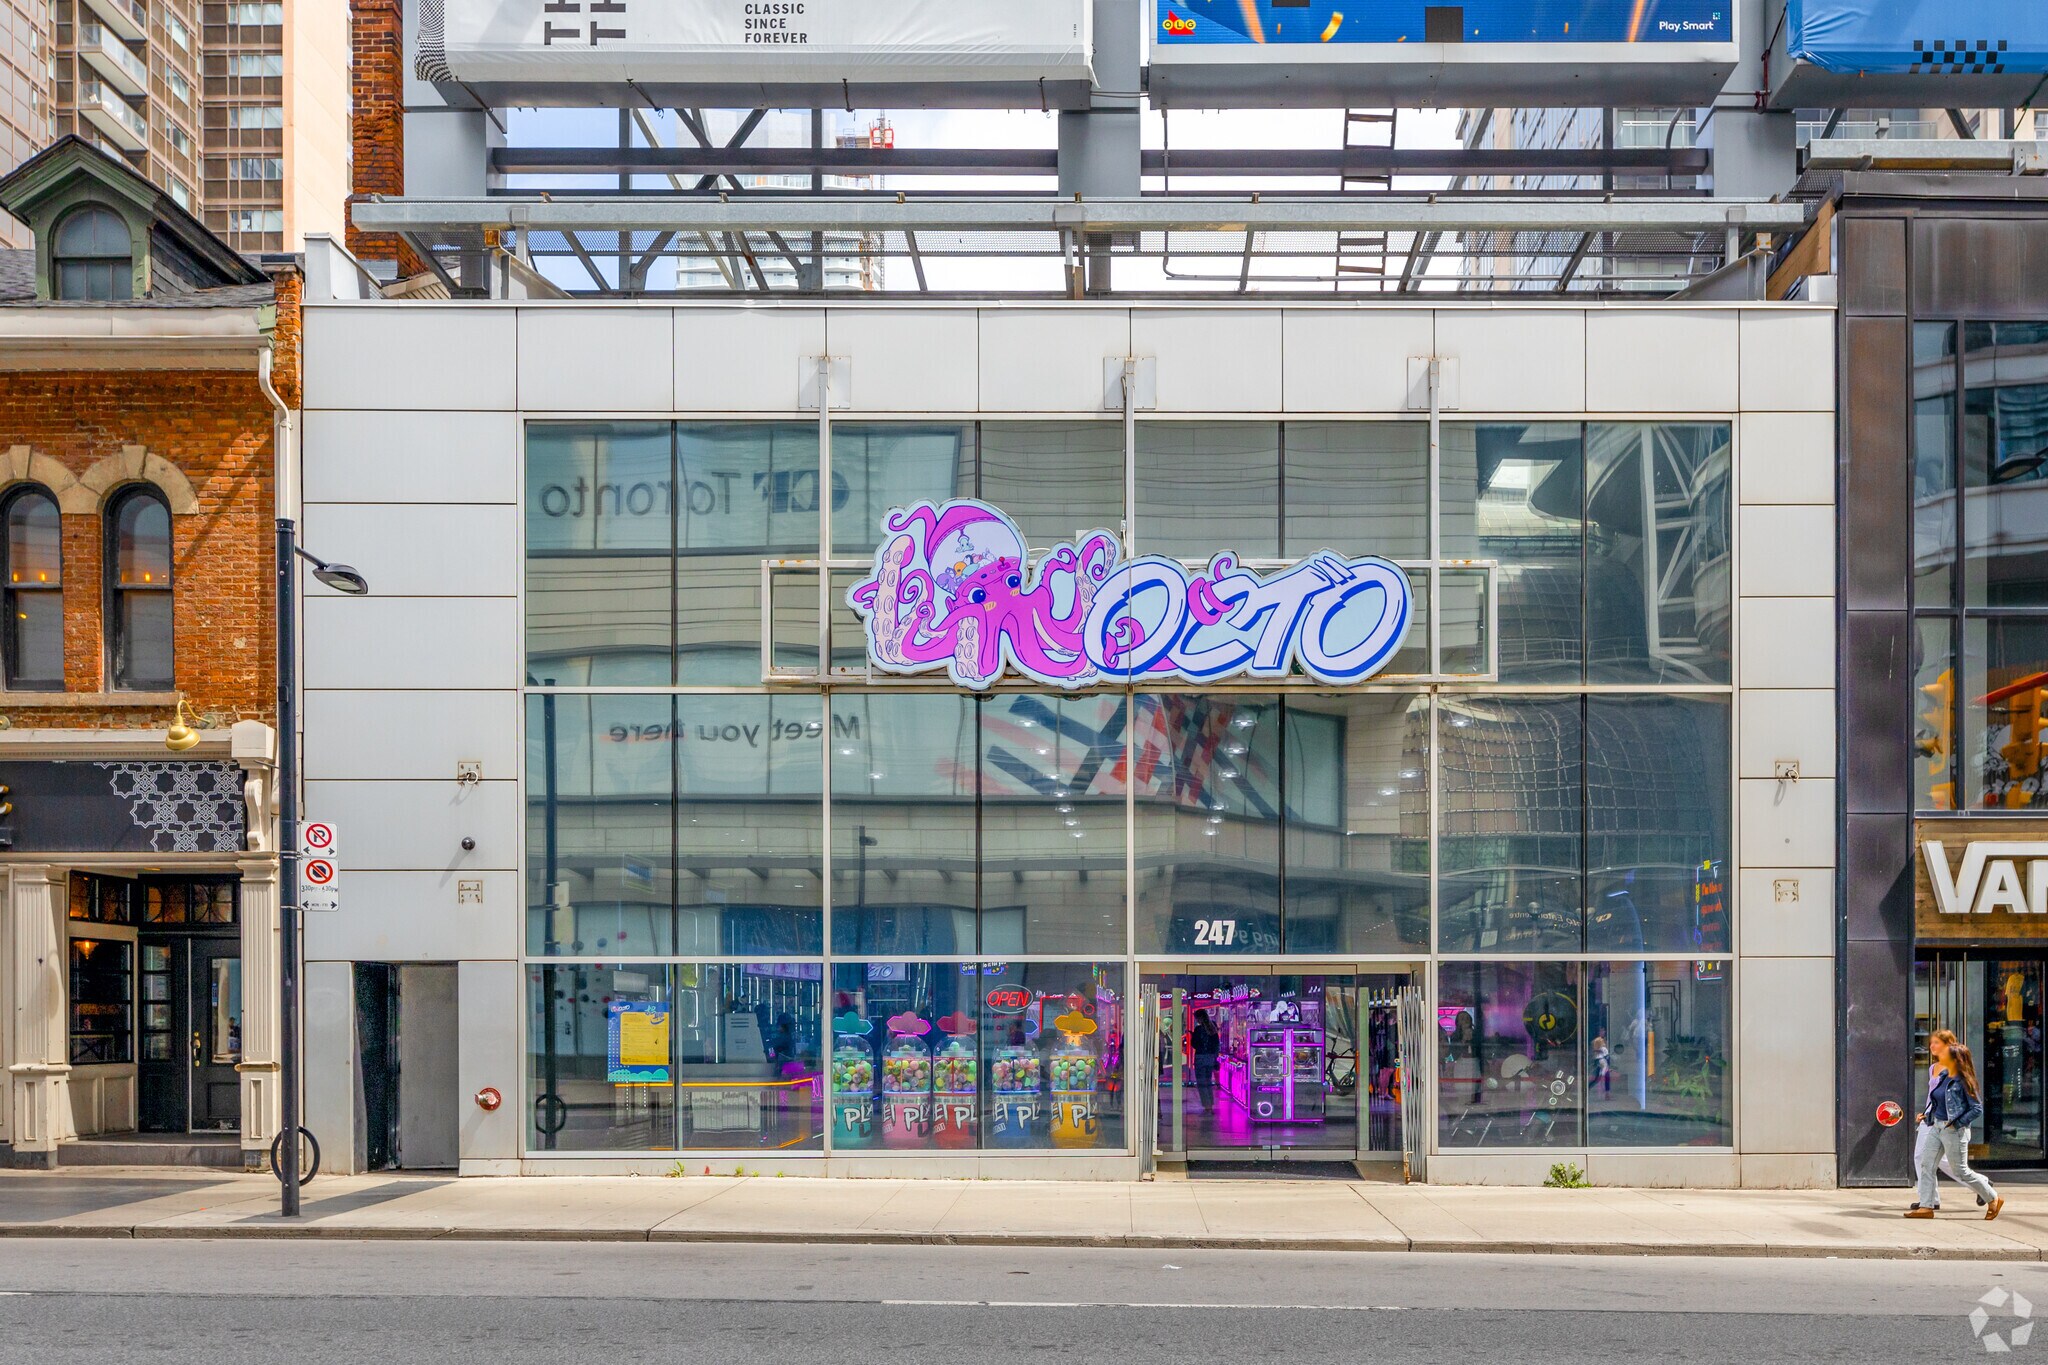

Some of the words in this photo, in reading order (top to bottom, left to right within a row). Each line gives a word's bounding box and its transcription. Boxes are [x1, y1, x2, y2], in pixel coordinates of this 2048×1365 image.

[744, 3, 805, 15] CLASSIC
[744, 18, 787, 29] SINCE
[1162, 20, 1196, 30] OLG
[744, 32, 808, 43] FOREVER
[1194, 920, 1236, 946] 247
[988, 991, 1029, 1007] OPEN
